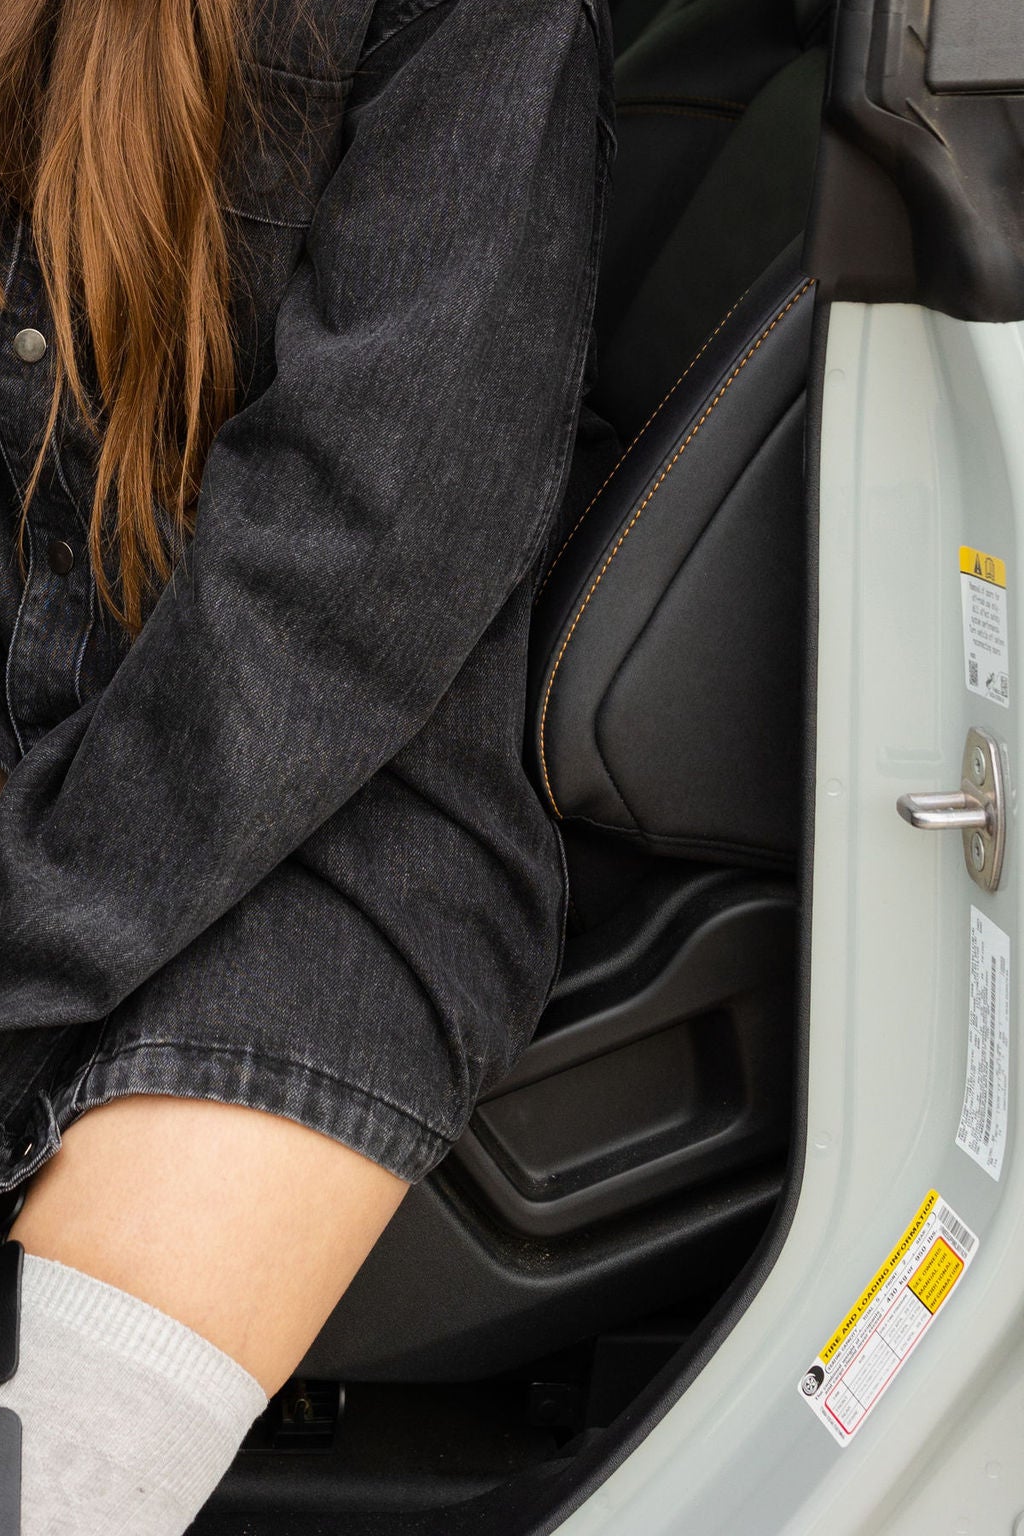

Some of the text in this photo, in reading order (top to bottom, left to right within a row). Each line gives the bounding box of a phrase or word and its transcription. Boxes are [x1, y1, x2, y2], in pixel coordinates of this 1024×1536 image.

[823, 1335, 841, 1360] TIRE
[841, 1312, 857, 1334] AND
[857, 1266, 889, 1312] LOADING
[889, 1195, 935, 1266] INFORMATION
[885, 1286, 898, 1304] 430
[914, 1245, 926, 1262] 950
[917, 1251, 948, 1297] MANUAL FOR
[924, 1260, 952, 1301] ADDITIONAL
[928, 1261, 961, 1310] INFORMATION
